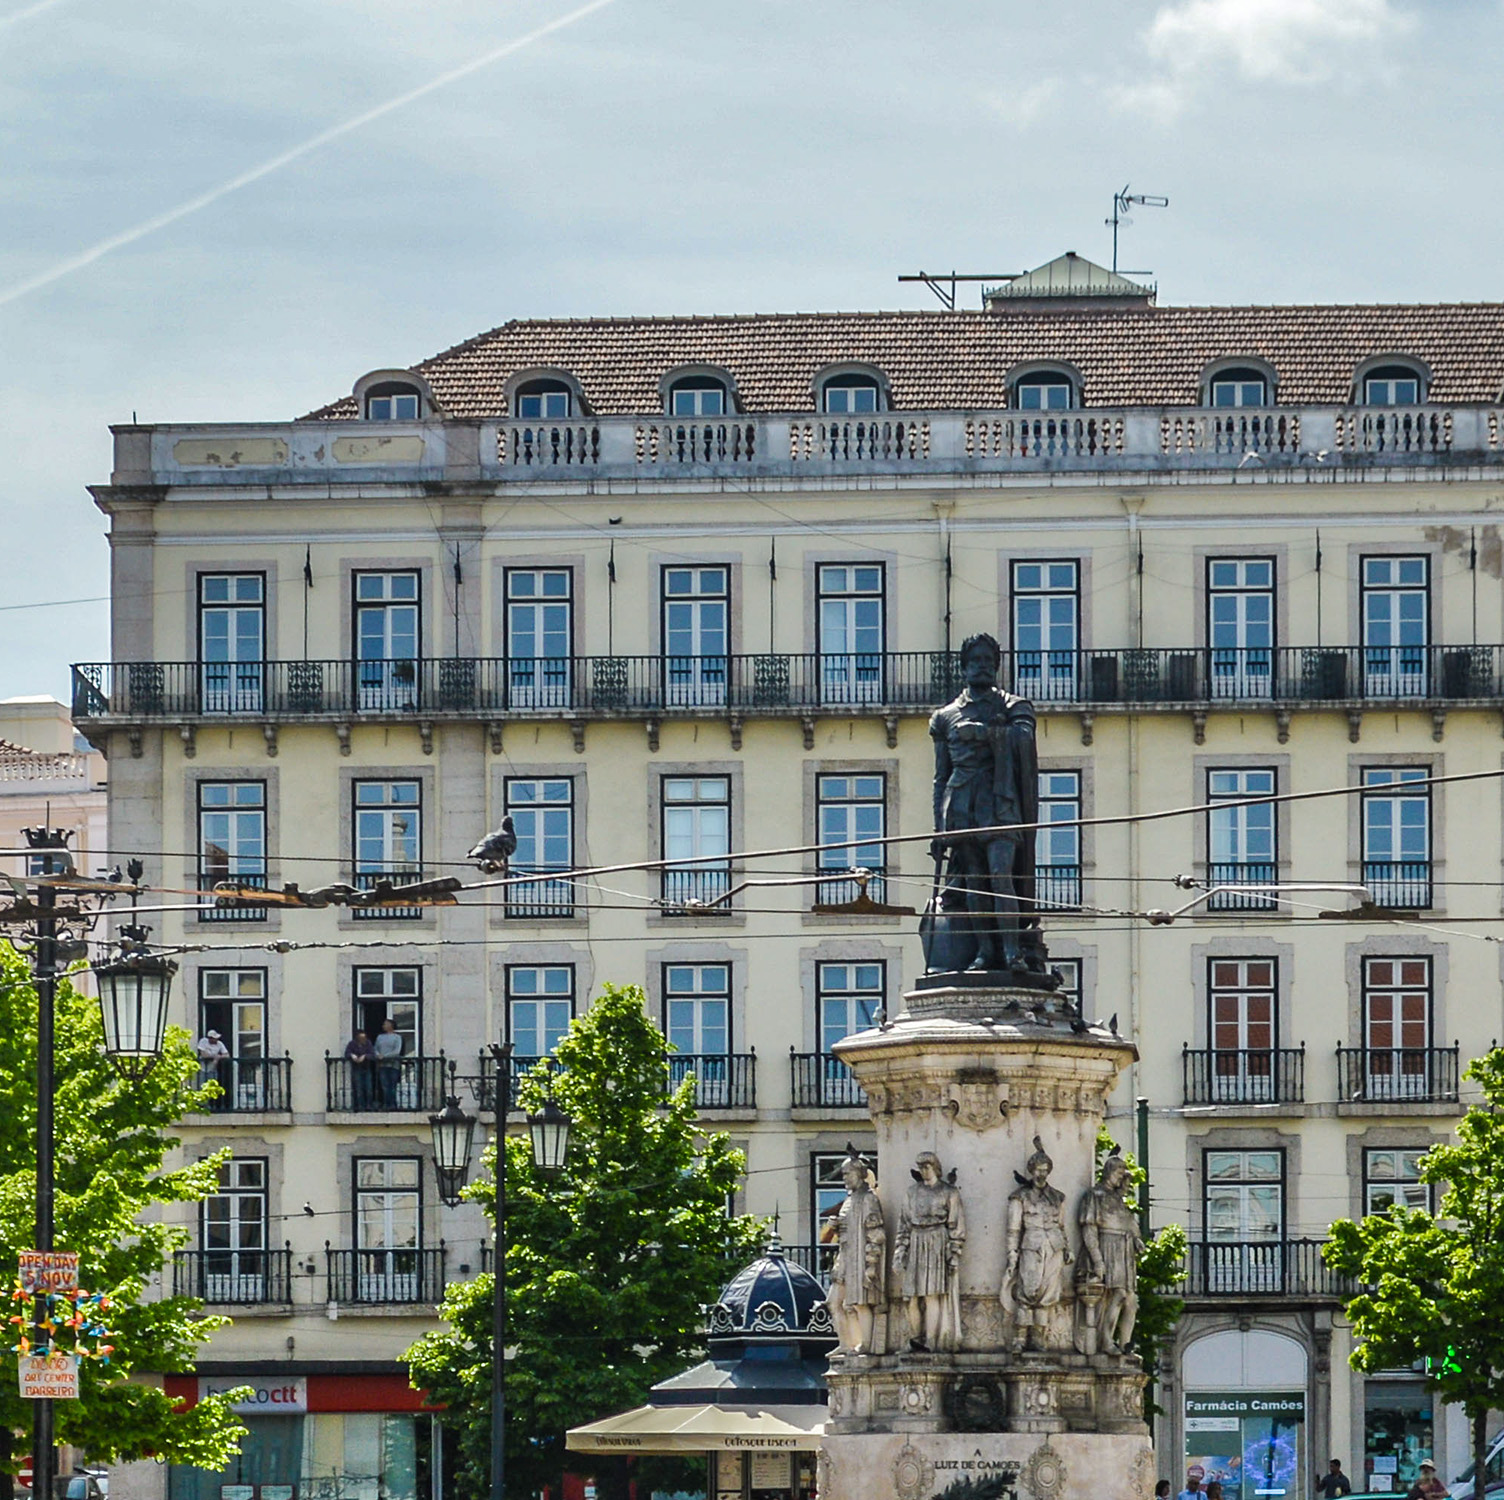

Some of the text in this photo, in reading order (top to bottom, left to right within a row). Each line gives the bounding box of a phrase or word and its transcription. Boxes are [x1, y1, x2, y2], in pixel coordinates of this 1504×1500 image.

[19, 1255, 77, 1270] OPEN DAY
[26, 1270, 72, 1286] 5 NOV
[25, 1373, 41, 1382] ART
[1186, 1399, 1304, 1411] Farmácia Camões
[974, 1448, 982, 1457] A
[934, 1461, 959, 1470] LUIZ
[961, 1461, 975, 1470] DE
